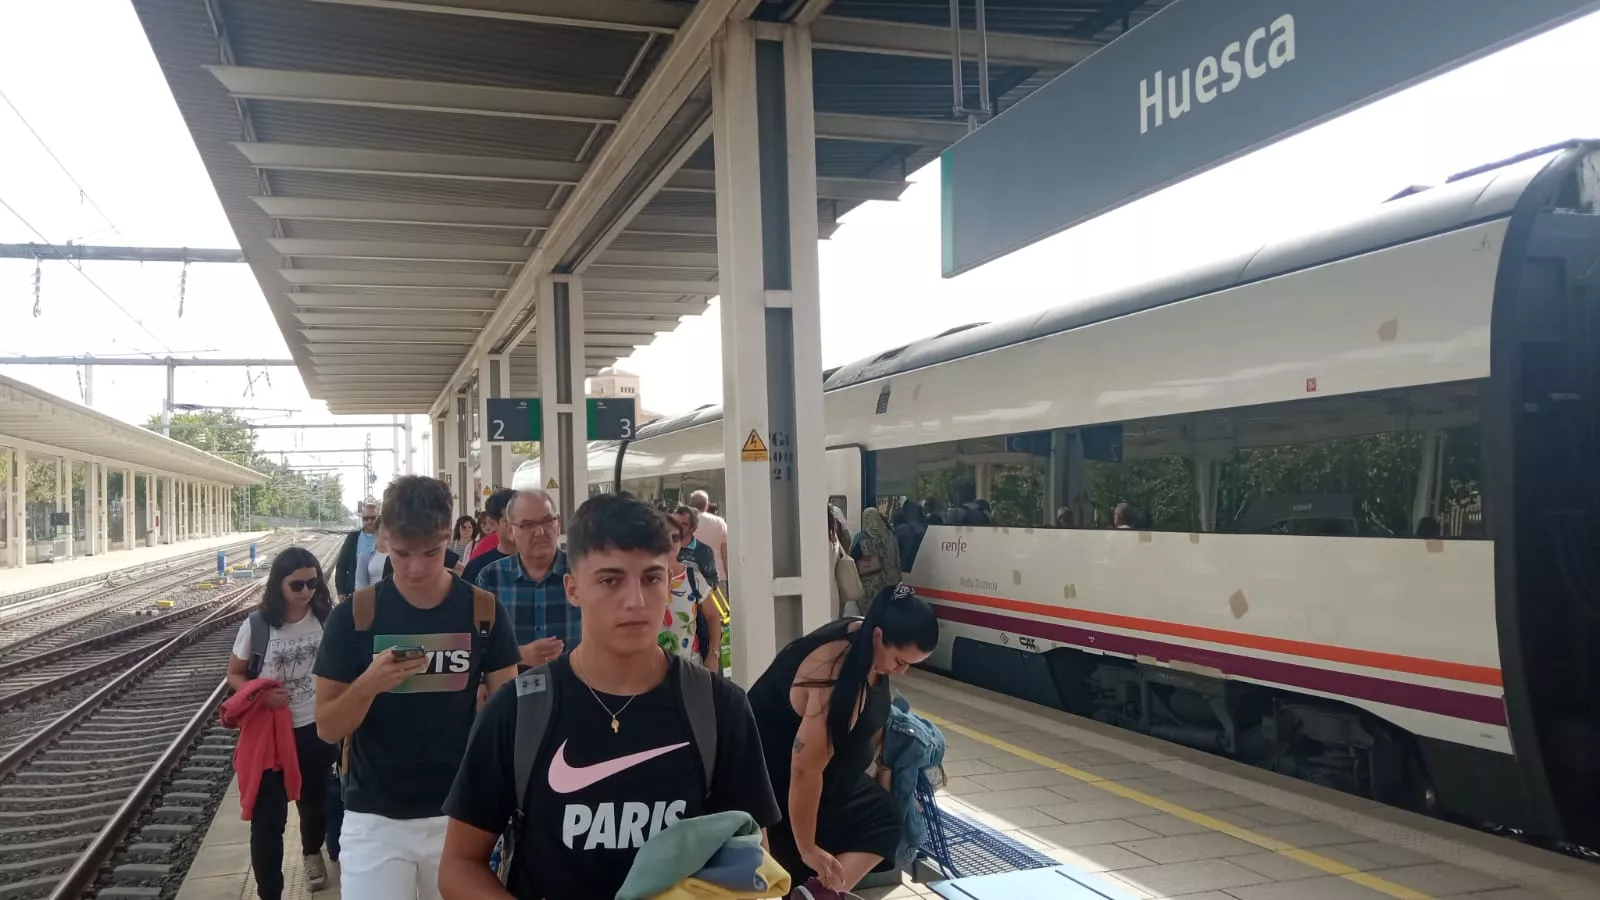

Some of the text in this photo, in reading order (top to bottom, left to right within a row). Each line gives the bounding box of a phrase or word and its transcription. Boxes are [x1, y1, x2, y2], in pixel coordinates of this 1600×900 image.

[1139, 13, 1296, 135] Huesca
[493, 420, 505, 440] 2
[620, 419, 631, 438] 3
[941, 535, 967, 559] renfe
